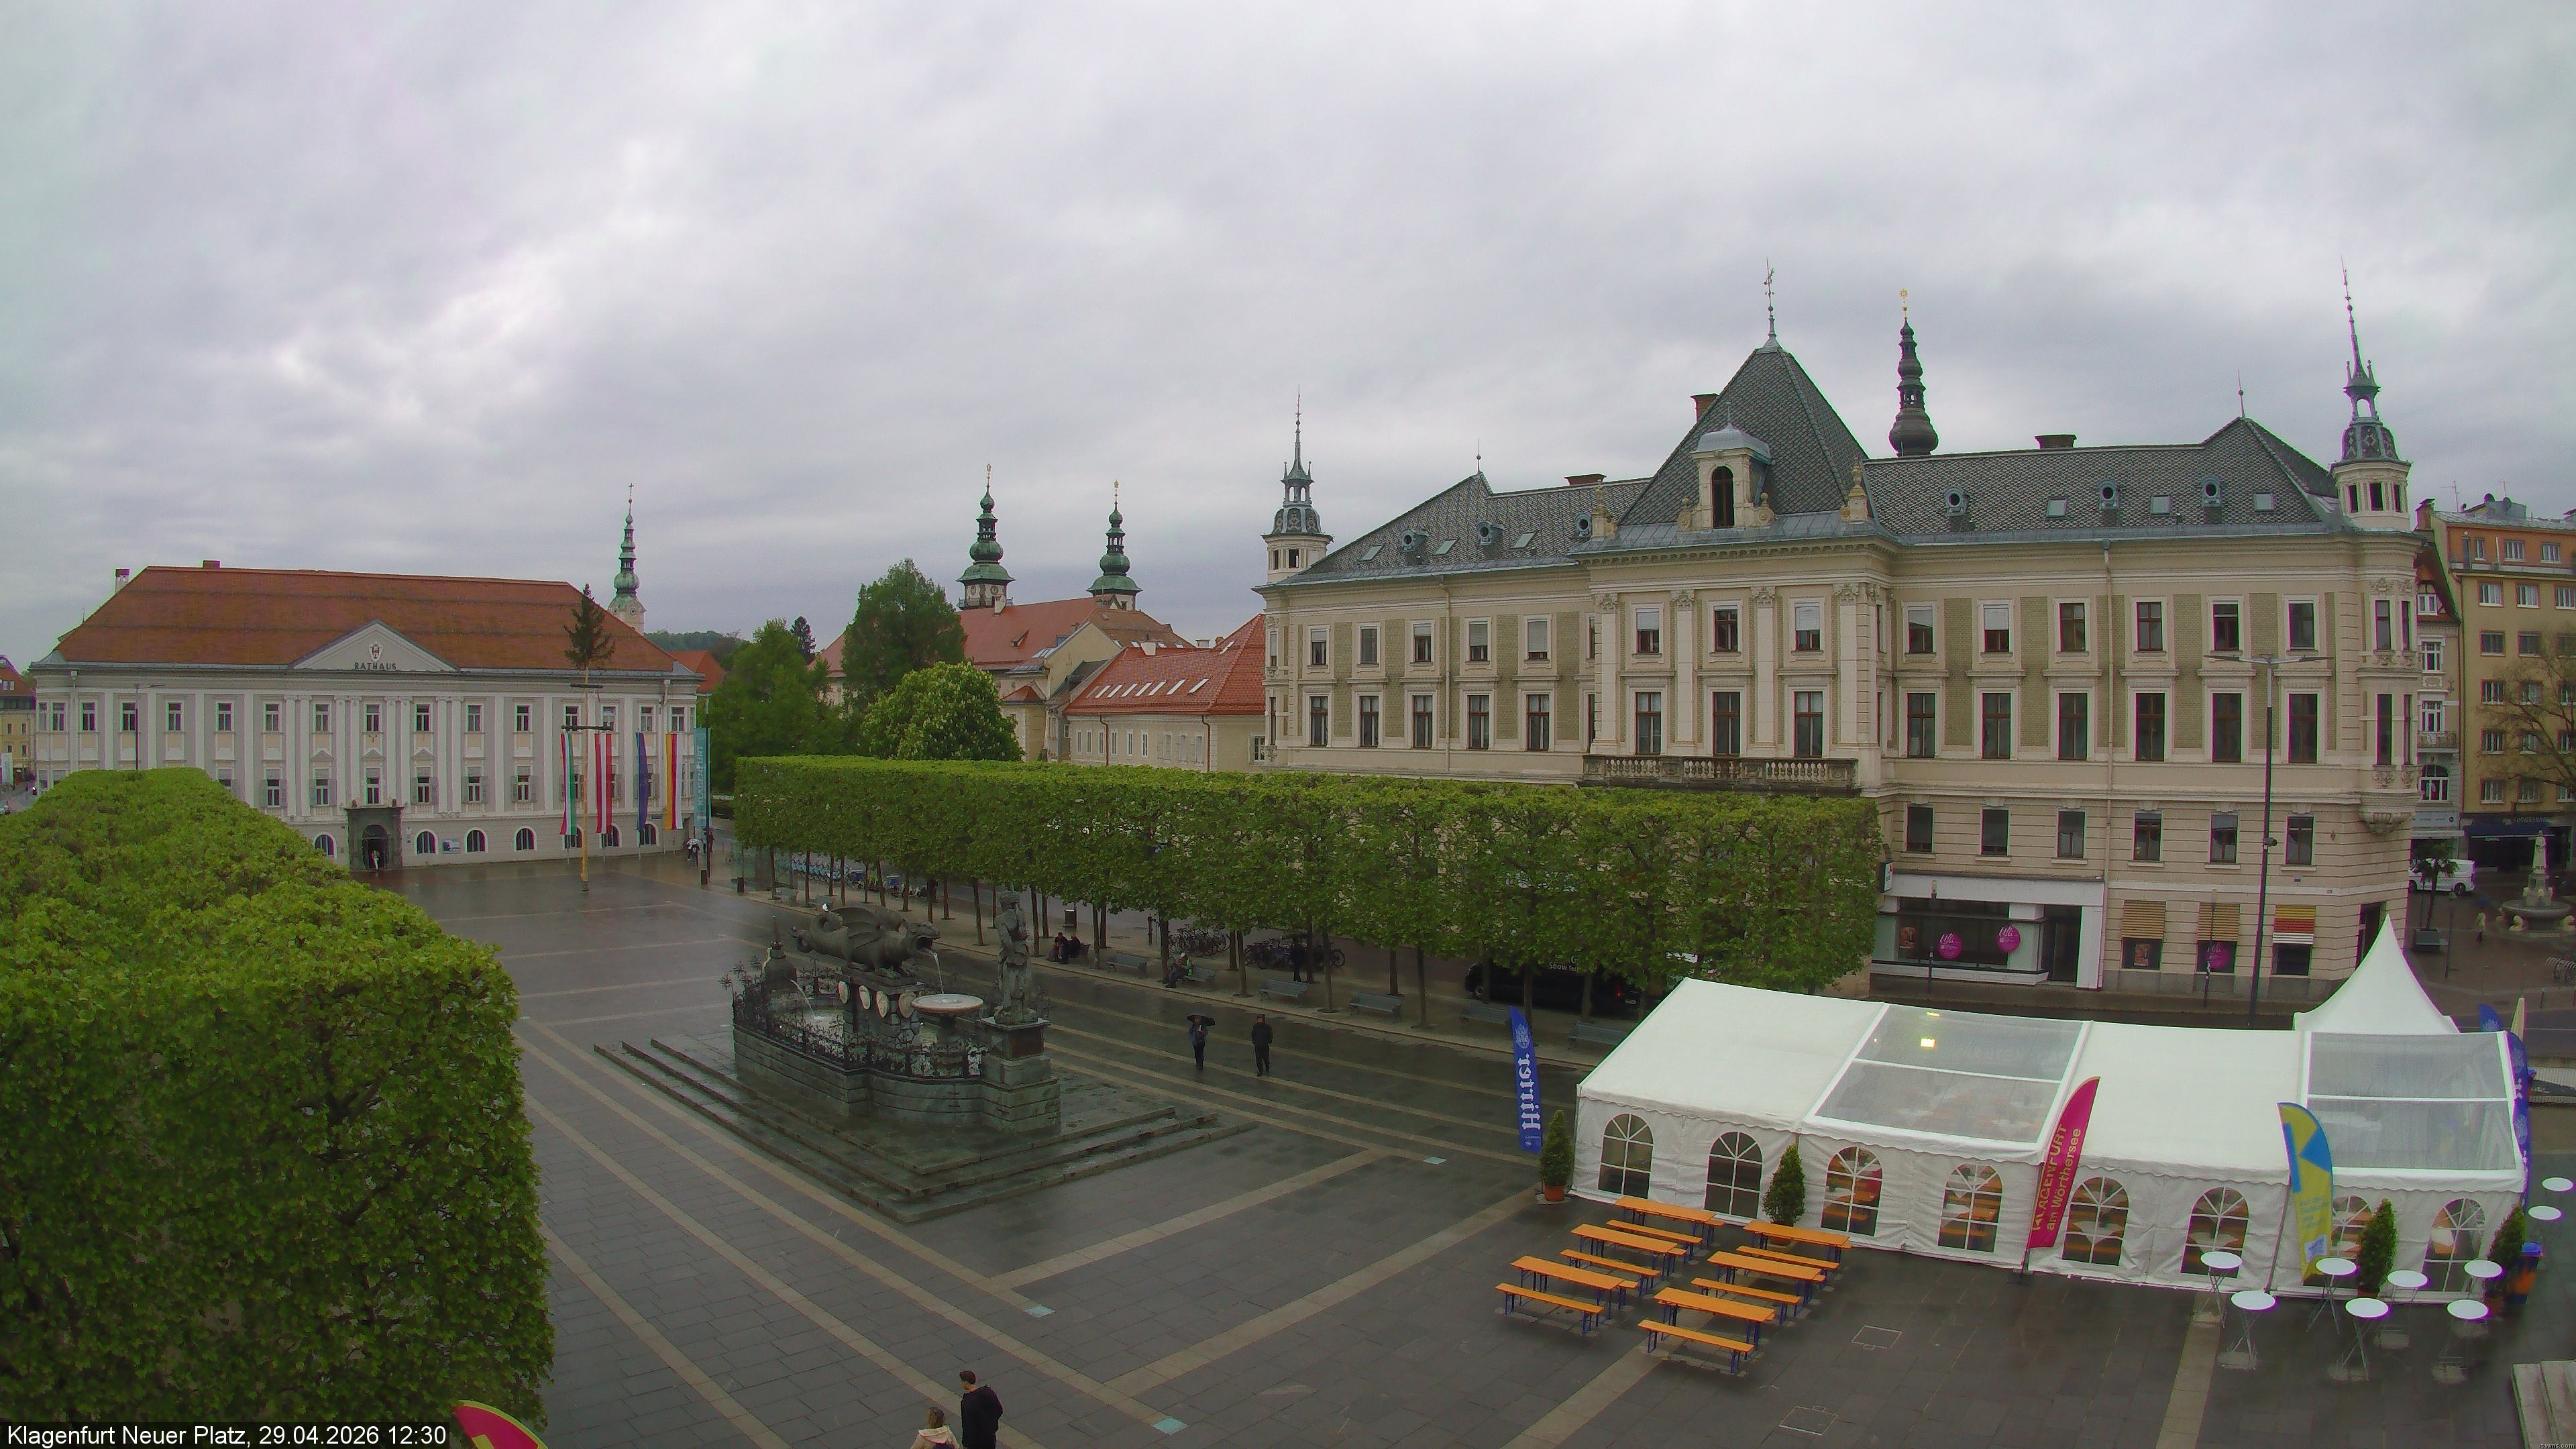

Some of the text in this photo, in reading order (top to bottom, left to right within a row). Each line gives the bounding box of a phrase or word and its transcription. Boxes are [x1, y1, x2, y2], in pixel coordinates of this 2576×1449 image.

[354, 661, 396, 670] RATHAUS
[1549, 961, 1567, 971] Show
[1517, 1053, 1541, 1130] Hirter
[2032, 1124, 2067, 1232] KLAGENFURT
[2047, 1128, 2081, 1230] am Wörthersee
